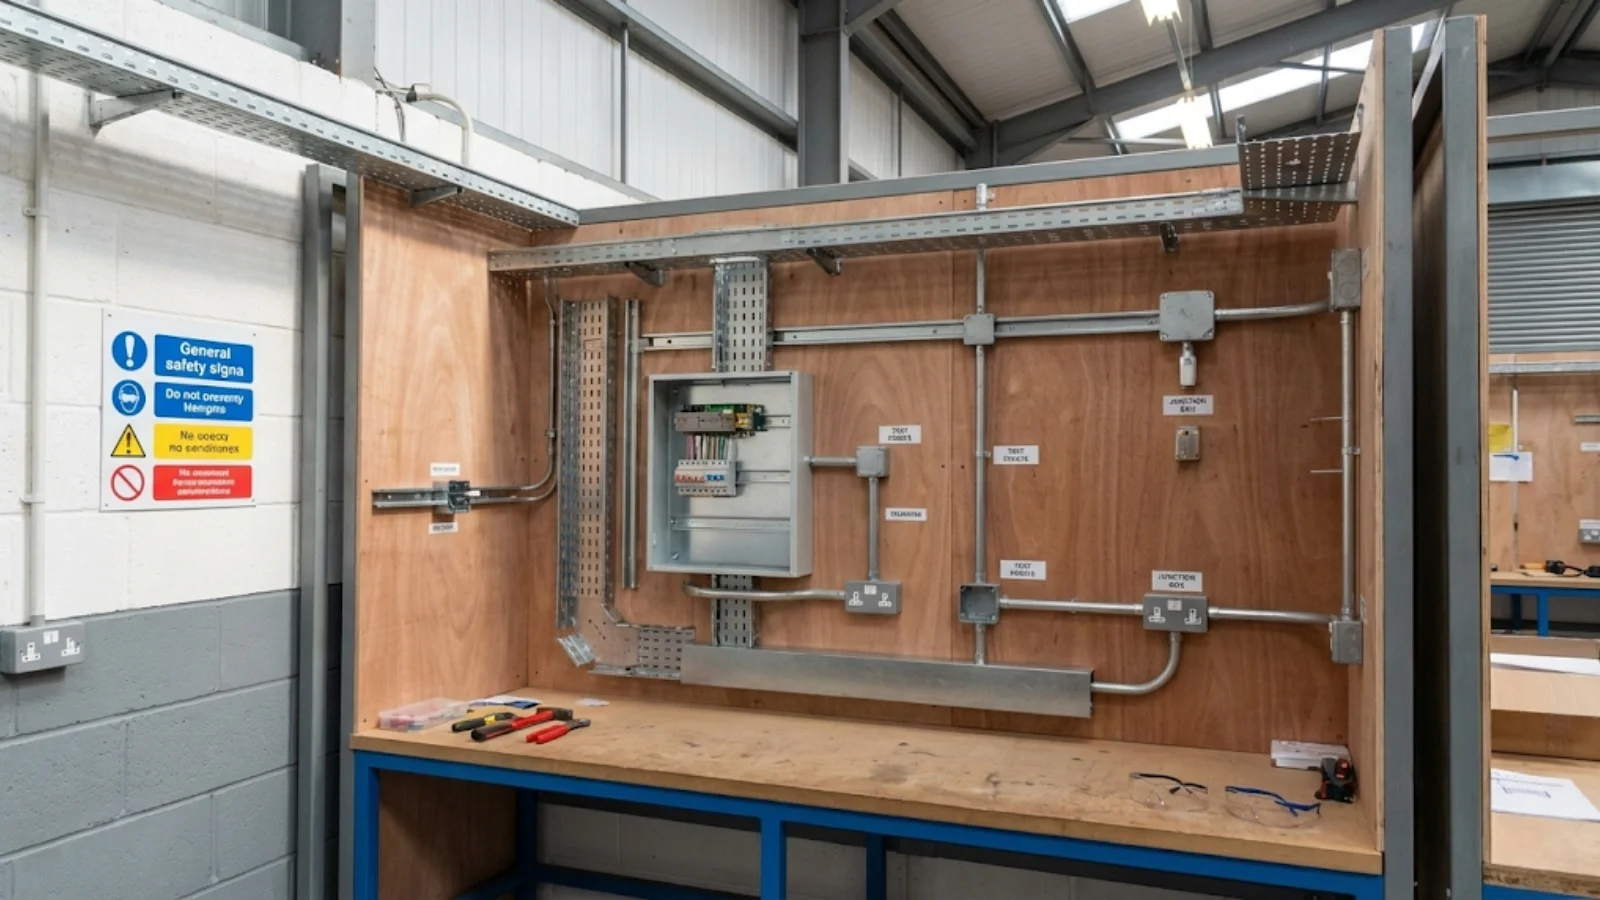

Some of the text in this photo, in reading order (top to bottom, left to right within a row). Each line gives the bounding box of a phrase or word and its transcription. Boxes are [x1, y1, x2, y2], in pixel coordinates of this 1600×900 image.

[180, 341, 231, 360] General
[165, 358, 206, 377] safety
[165, 388, 181, 400] Do
